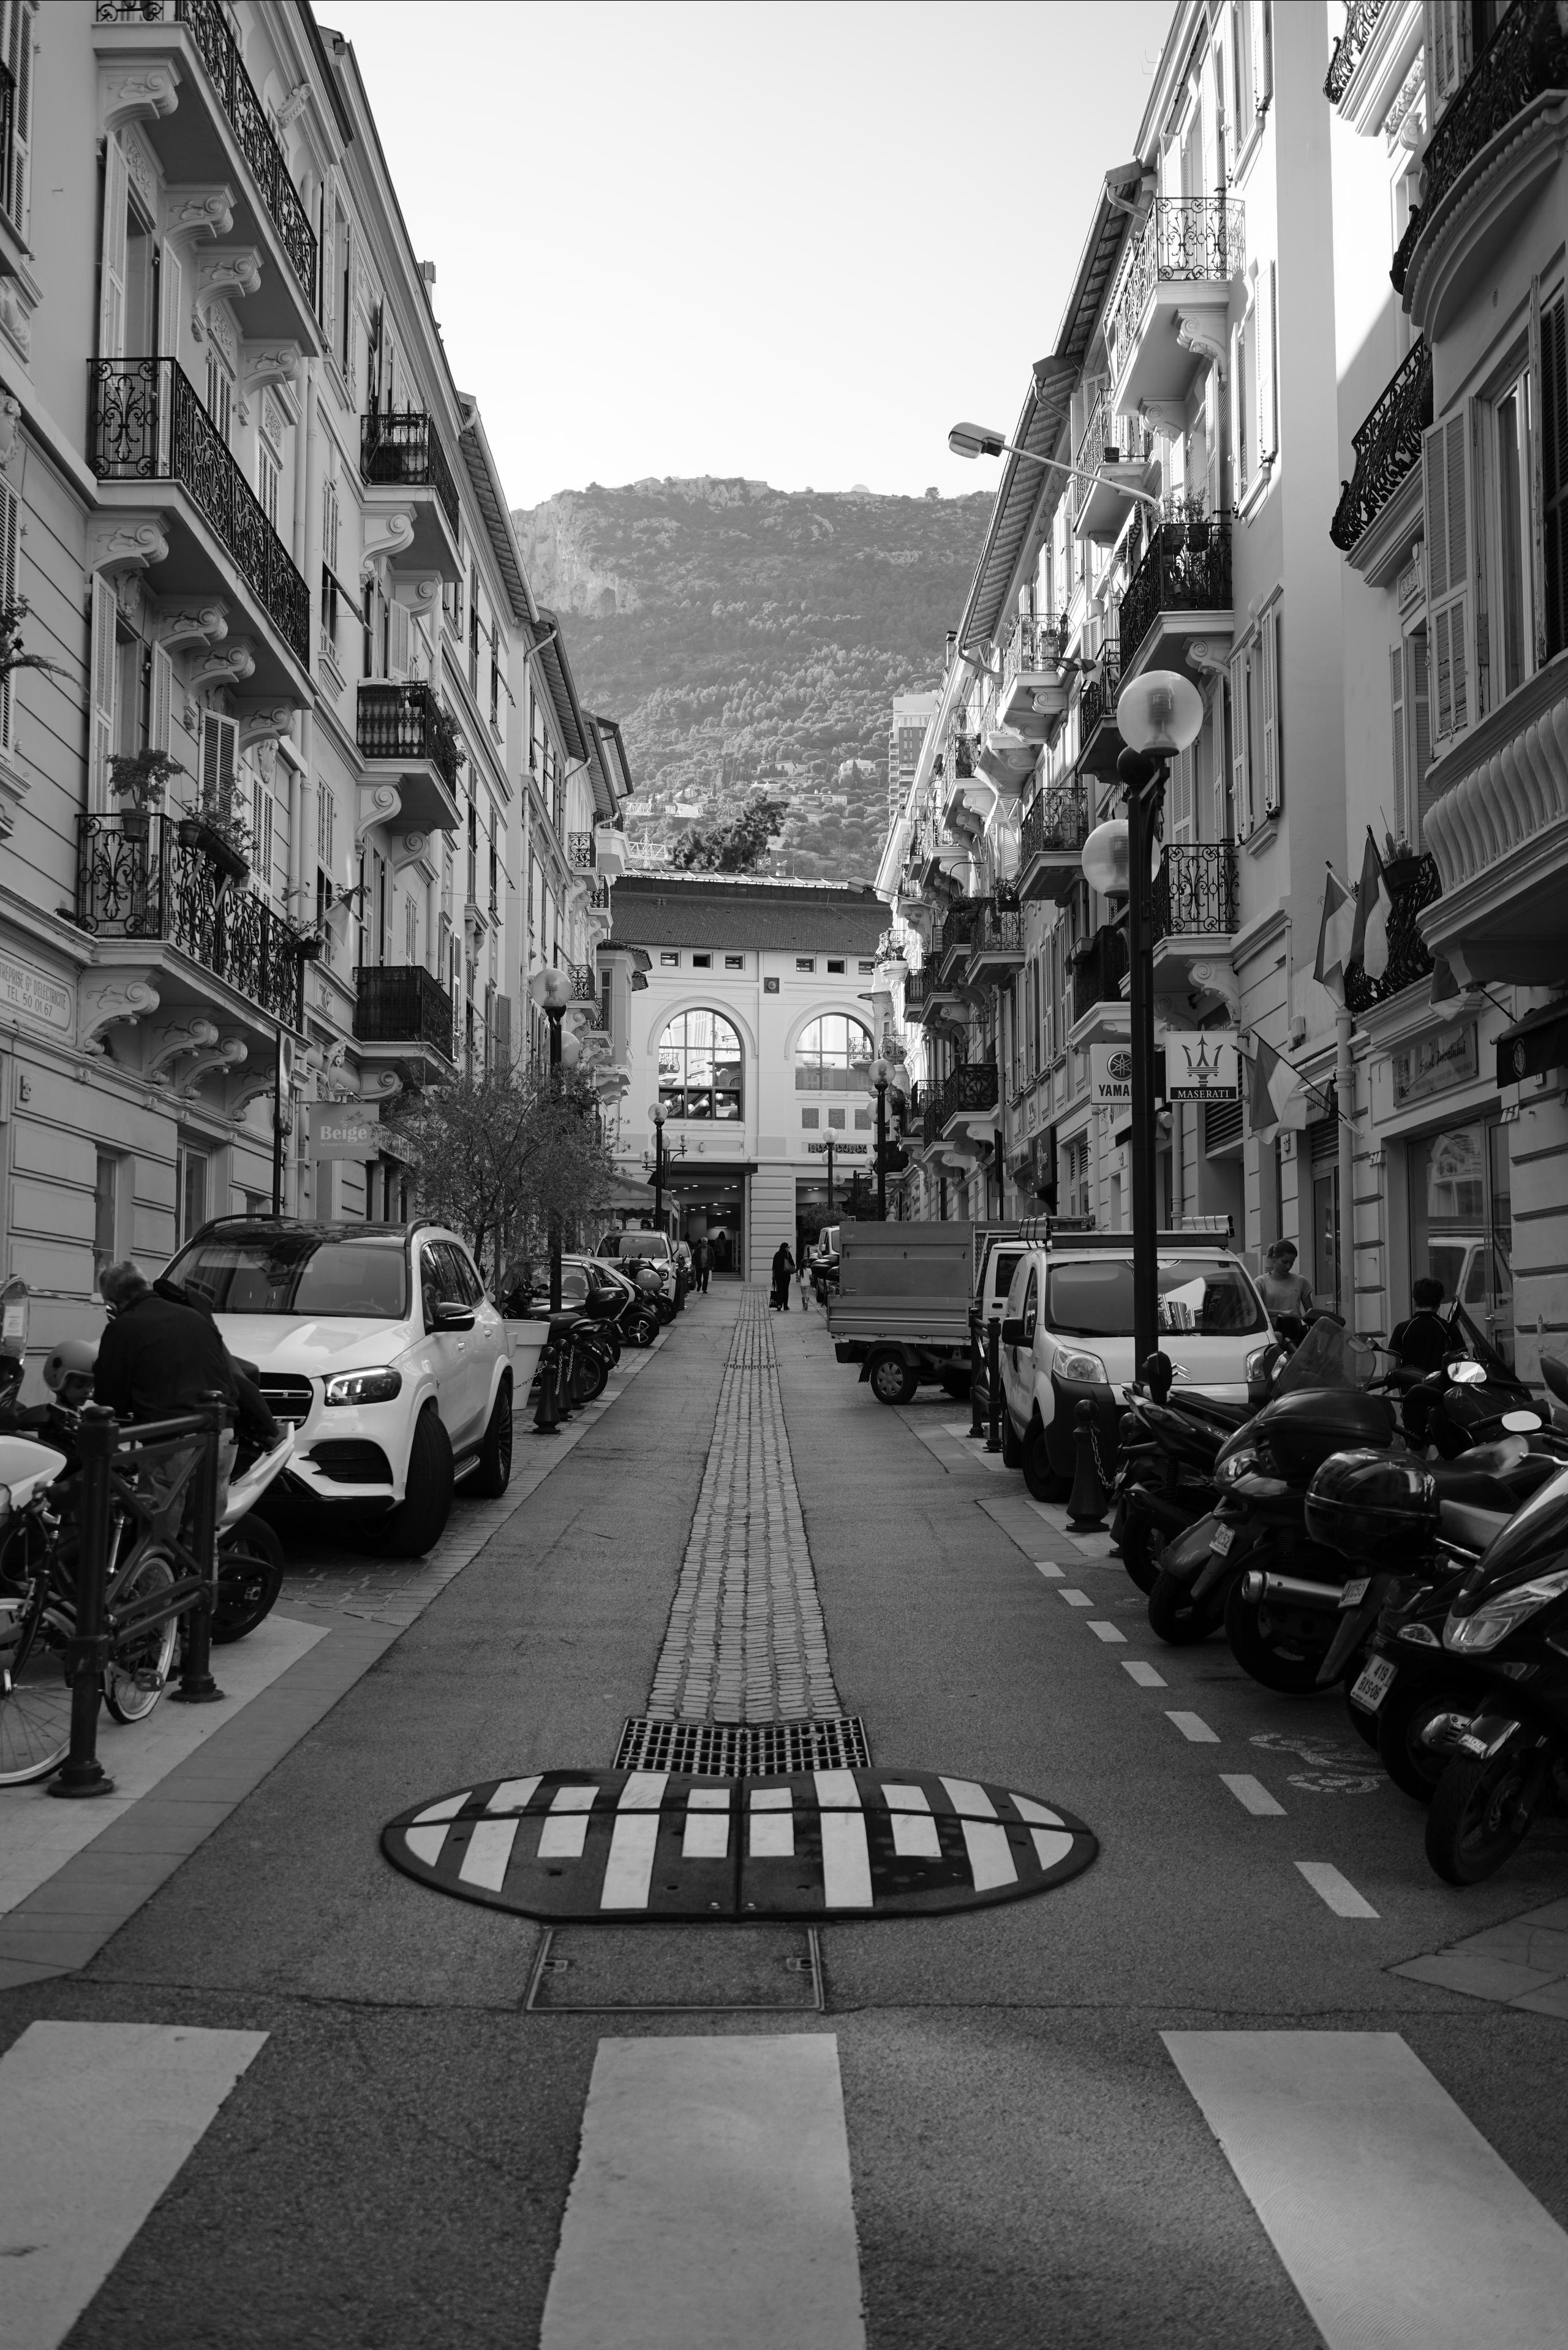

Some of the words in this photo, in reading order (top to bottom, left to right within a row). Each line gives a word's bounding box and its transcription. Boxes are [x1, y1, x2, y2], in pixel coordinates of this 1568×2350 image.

[1099, 1084, 1132, 1096] YAMA
[1177, 1090, 1229, 1098] MASERATI
[320, 1126, 367, 1142] Beige
[1374, 1663, 1389, 1681] 419
[1358, 1676, 1382, 1700] BXS-06
